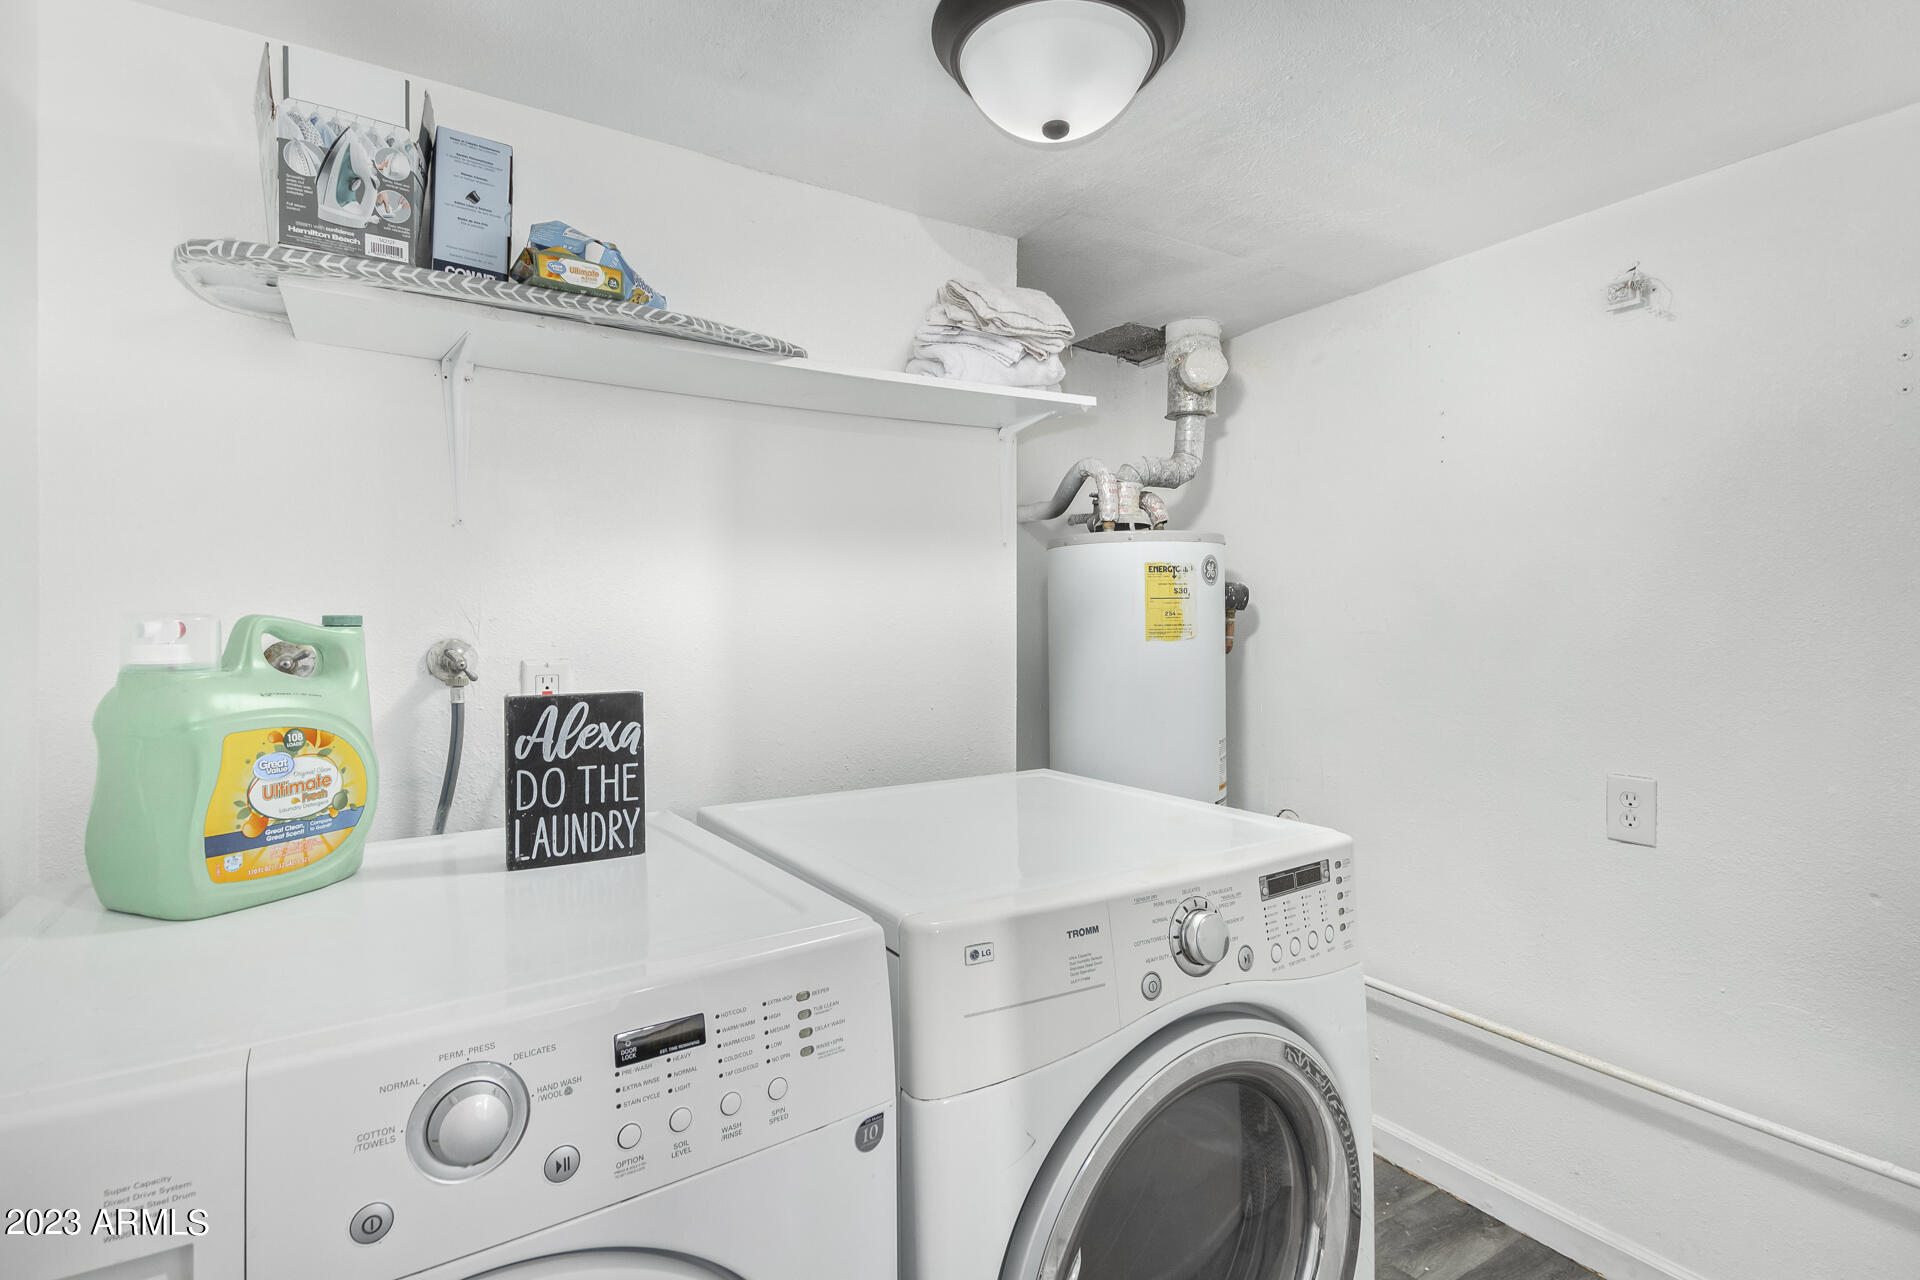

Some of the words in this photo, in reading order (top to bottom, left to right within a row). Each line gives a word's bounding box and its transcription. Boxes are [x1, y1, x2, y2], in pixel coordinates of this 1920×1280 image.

[287, 225, 331, 239] Hamilton
[331, 233, 361, 245] Beach
[287, 733, 304, 743] 108
[515, 701, 642, 762] Alexa
[259, 758, 288, 770] Great
[266, 766, 288, 775] Value
[262, 774, 332, 800] Ultimate
[516, 767, 566, 811] DO
[577, 763, 639, 804] THE
[301, 788, 328, 802] Fresh
[265, 827, 284, 835] Great
[266, 833, 285, 841] Great
[514, 807, 641, 860] LAUNDRY
[1066, 925, 1100, 939] TROMM
[981, 948, 992, 958] LG
[769, 1024, 790, 1034] MEDIUM
[814, 1023, 830, 1032] DELAY
[620, 1046, 637, 1056] DOOR
[770, 1041, 782, 1049] LOW
[438, 1050, 467, 1062] PERM.
[467, 1042, 496, 1054] PRESS
[512, 1043, 557, 1061] DELICATES
[621, 1053, 637, 1061] LOCK
[672, 1052, 692, 1062] HEAVY
[673, 1066, 698, 1077] NORMAL
[379, 1077, 421, 1094] NORMAL
[536, 1082, 558, 1094] HAND
[558, 1075, 583, 1088] WASH
[622, 1082, 642, 1092] EXTRA
[674, 1082, 691, 1093] LIGHT
[537, 1089, 564, 1103] /WOOL
[623, 1098, 642, 1108] STAIN
[642, 1092, 660, 1102] CYCLE
[771, 1106, 786, 1116] SPIN
[768, 1113, 789, 1125] SPEED
[721, 1121, 742, 1133] WASH
[356, 1126, 396, 1143] COTTON
[863, 1124, 878, 1144] 10
[353, 1135, 397, 1154] /TOWELS
[673, 1140, 689, 1150] SOIL
[671, 1147, 692, 1159] LEVEL
[615, 1154, 645, 1169] OPTION
[103, 1185, 131, 1197] Super
[133, 1175, 172, 1190] Capacity
[103, 1196, 130, 1208] Direct
[132, 1190, 156, 1201] Drive
[159, 1181, 192, 1194] System
[146, 1197, 169, 1208] Steel
[171, 1191, 197, 1202] Drum
